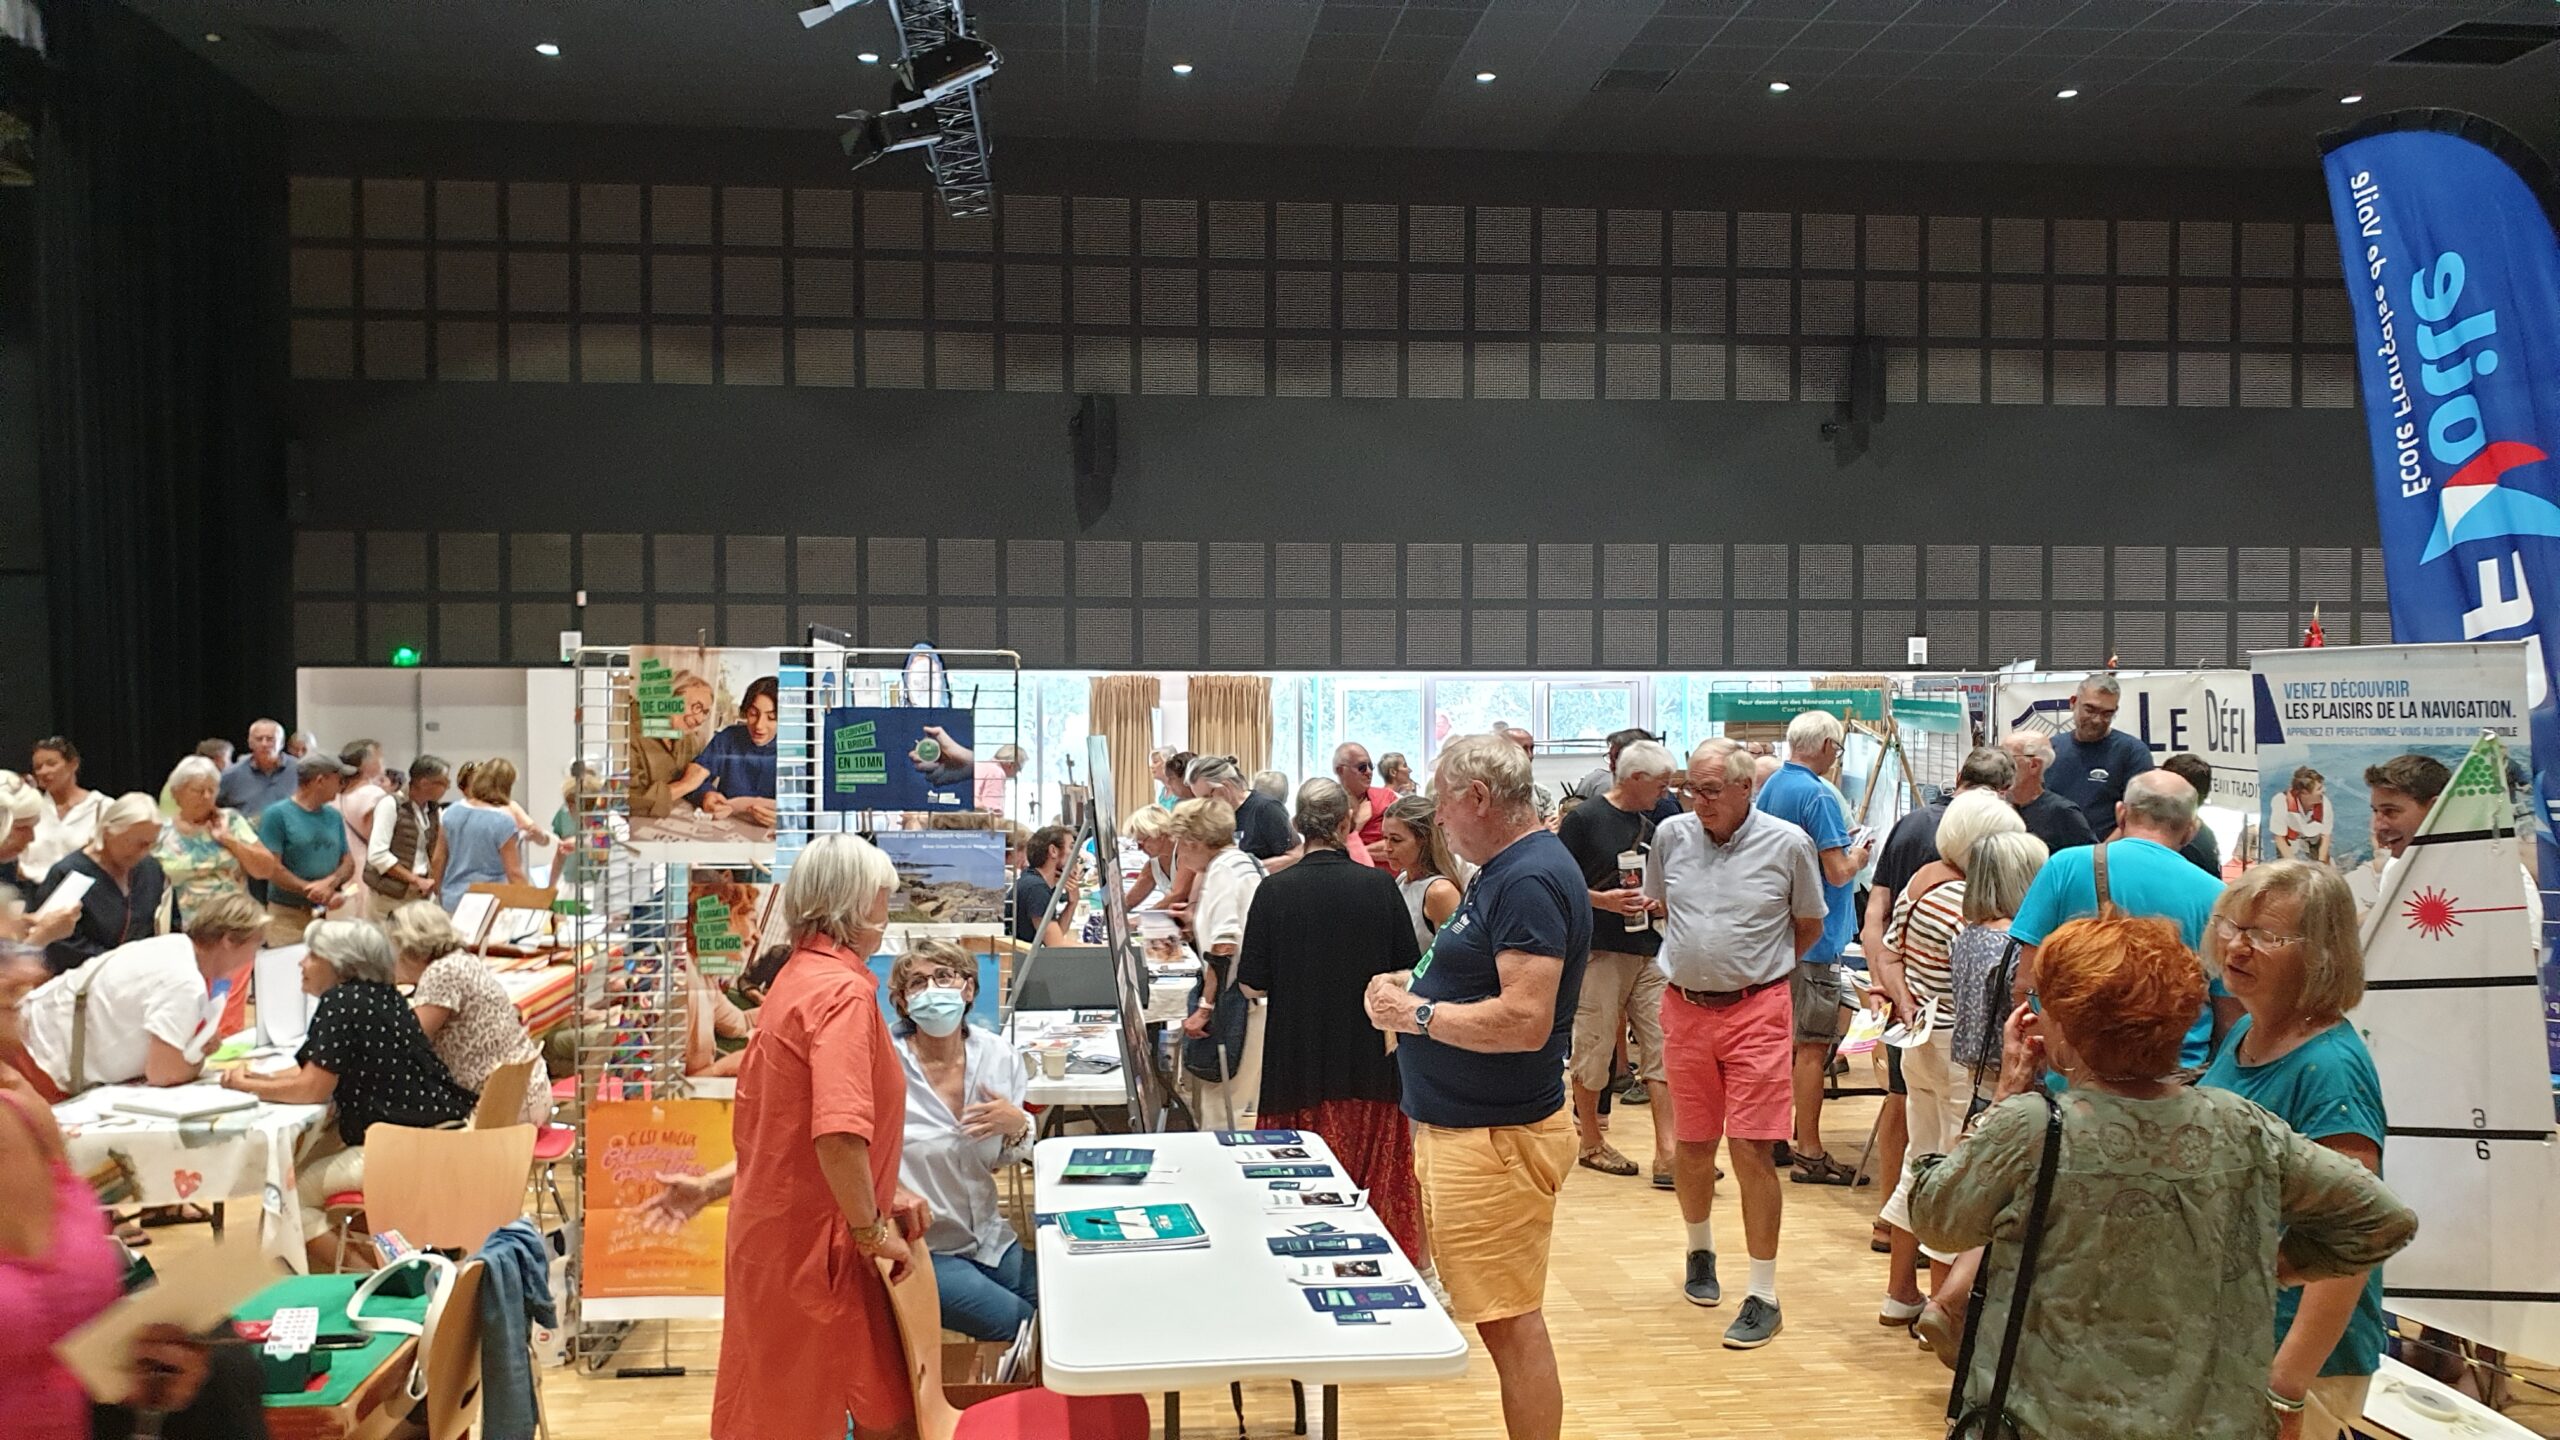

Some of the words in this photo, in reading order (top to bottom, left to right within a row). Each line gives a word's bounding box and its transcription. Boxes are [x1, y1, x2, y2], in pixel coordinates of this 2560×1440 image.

[2283, 682, 2327, 699] VENEZ
[2330, 678, 2410, 699] DÉCOUVRIR
[642, 700, 656, 713] DE
[657, 699, 685, 714] CHOC
[1737, 698, 1753, 706] Pour
[2285, 702, 2310, 720] LES
[2312, 702, 2374, 720] PLAISIRS
[2377, 701, 2396, 719] DE
[2399, 701, 2418, 719] LA
[2421, 700, 2517, 719] NAVIGATION.
[2138, 691, 2189, 752] LE
[2204, 688, 2246, 754] DÉFI
[2286, 726, 2324, 737] APPRENEZ
[837, 756, 851, 769] EN
[699, 938, 712, 951] DE
[714, 936, 742, 951] CHOC
